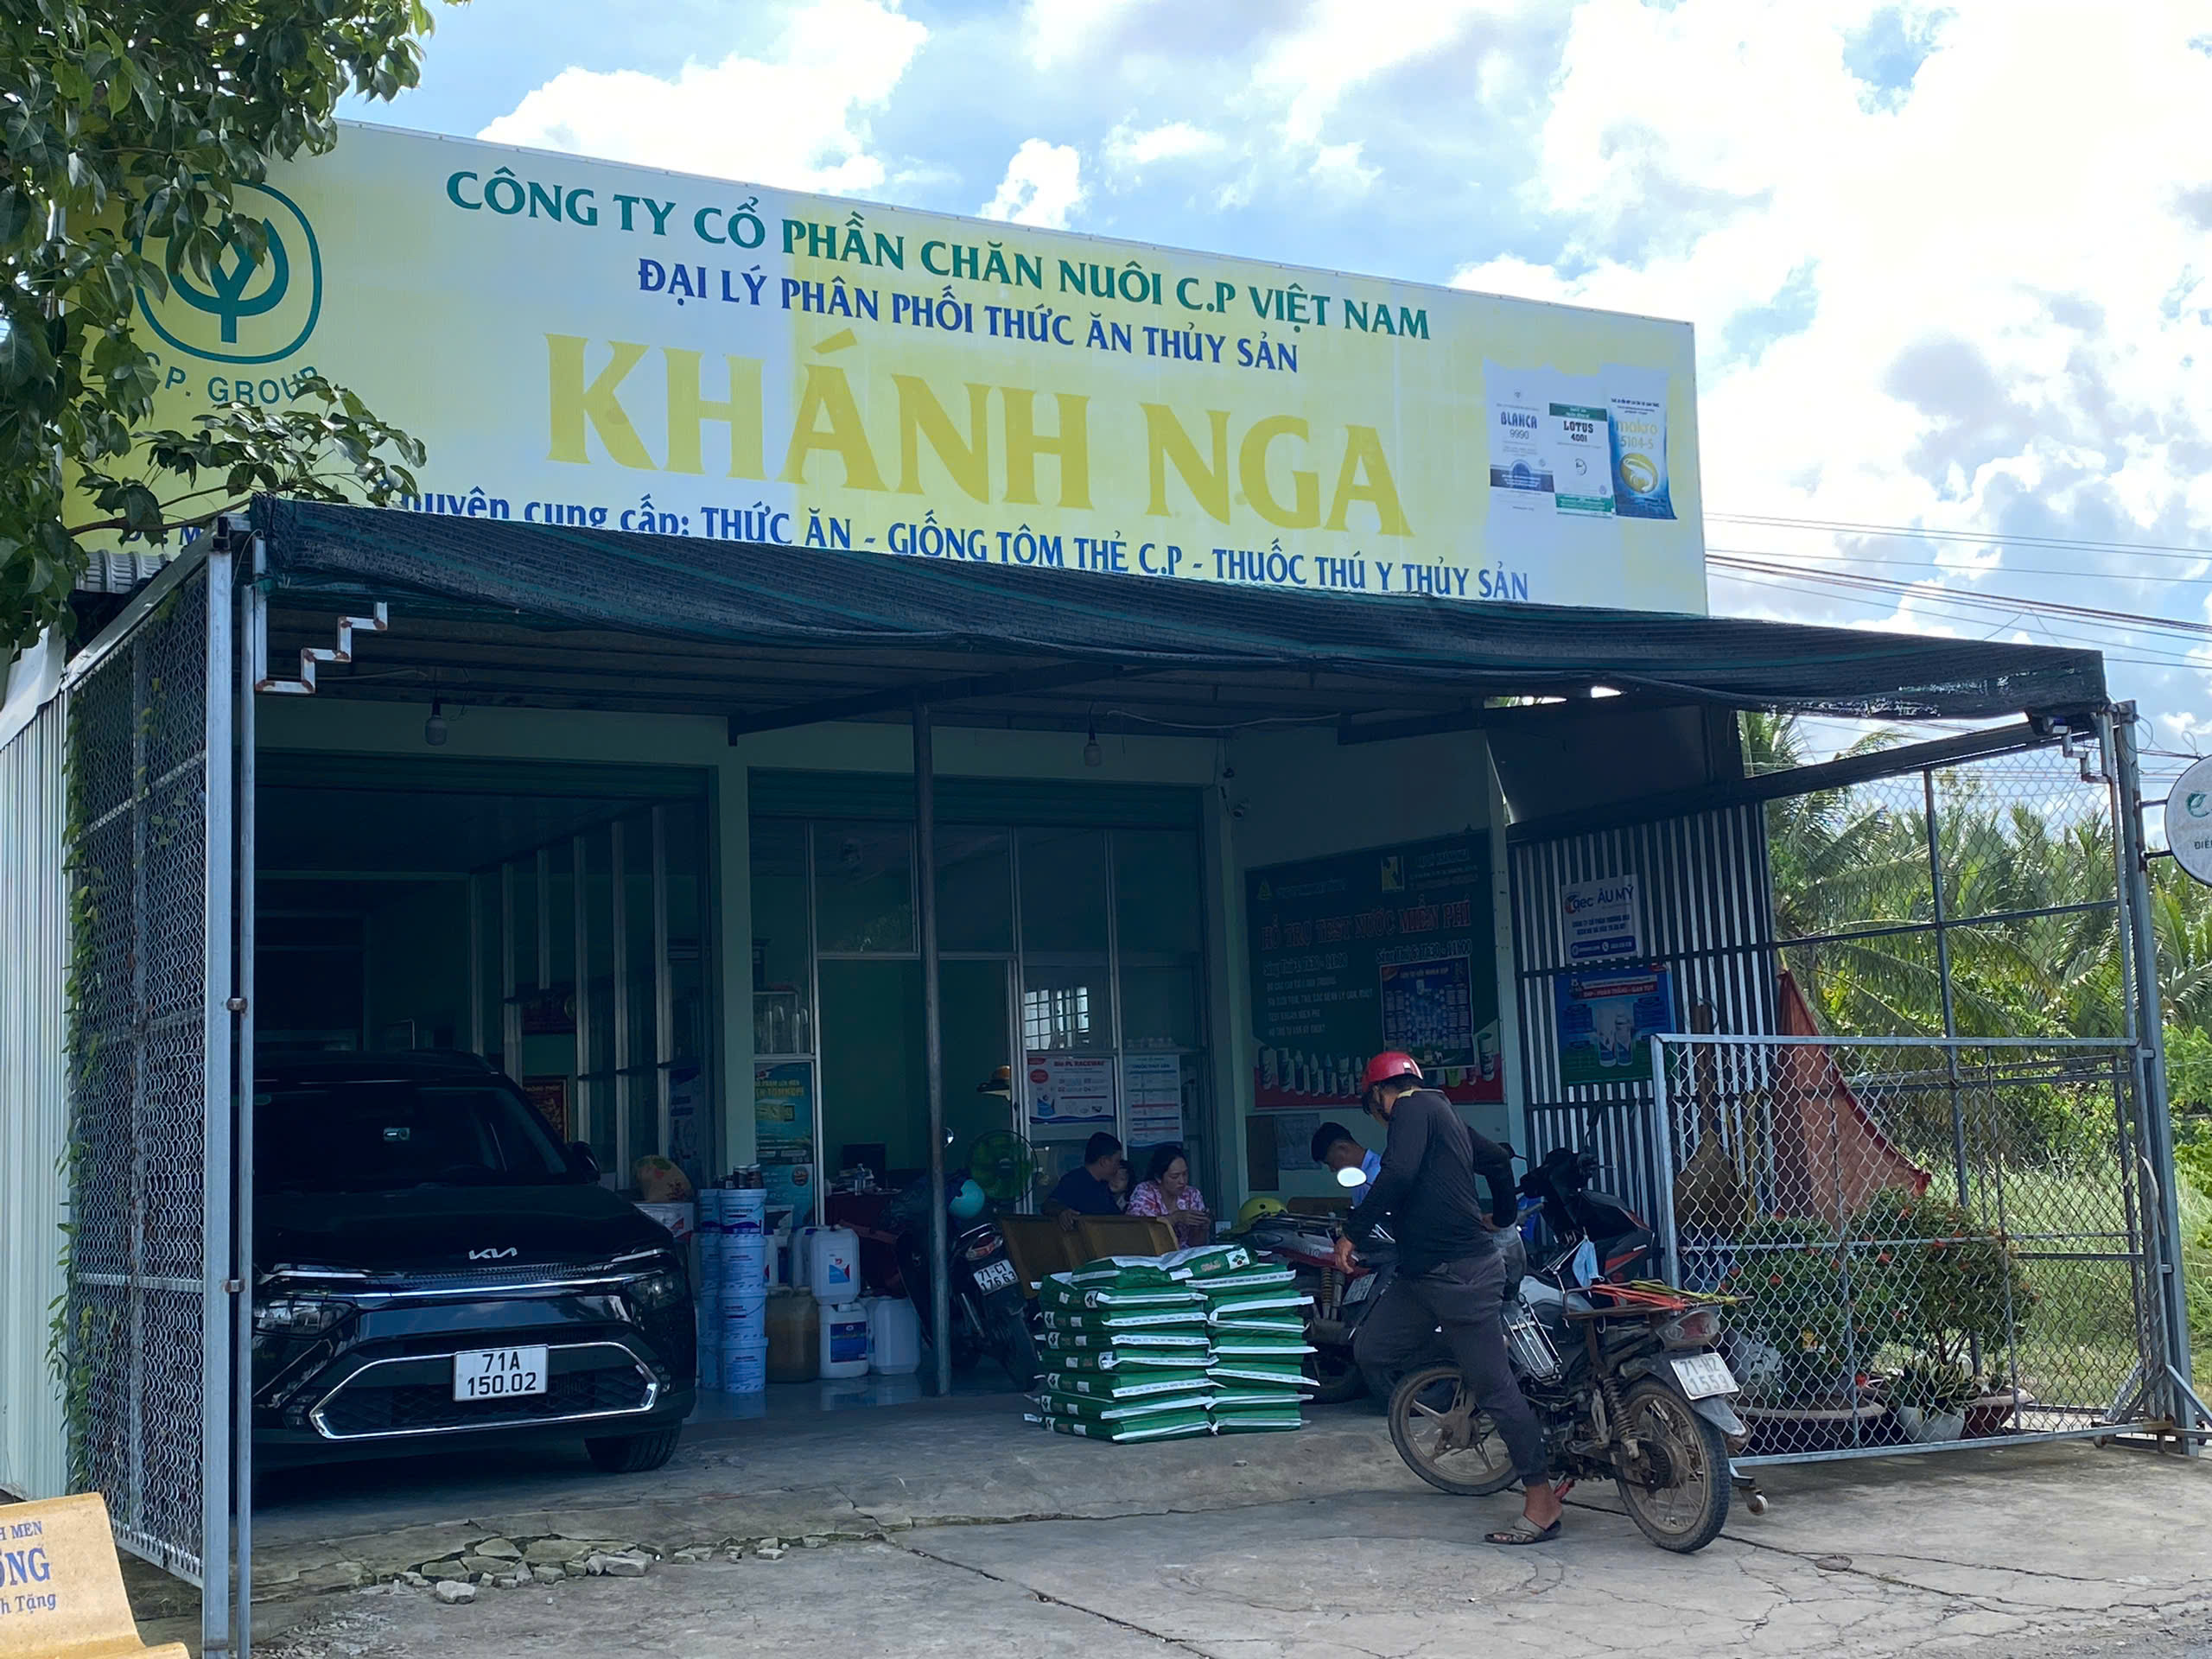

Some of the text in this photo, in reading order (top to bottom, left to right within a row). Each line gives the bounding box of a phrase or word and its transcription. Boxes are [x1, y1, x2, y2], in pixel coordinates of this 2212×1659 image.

[446, 165, 1431, 340] CÔNG TY CỔ PHẦN CHĂN NUÔI C.P VIỆT NAM
[638, 257, 1298, 373] ĐẠI LÝ PHÂN PHỐI THỨC ĂN THỦY SẢN
[1500, 410, 1538, 429] BLANCA
[1563, 421, 1594, 434] LOTUS
[544, 328, 1416, 539] KHÁNH NGA
[1571, 433, 1588, 443] 4001
[524, 502, 608, 527] cung
[701, 503, 792, 545] THỨC
[804, 507, 853, 549] ĂN
[887, 509, 988, 562] GIỐNG
[995, 524, 1065, 567] TÔM
[1073, 531, 1129, 571] THẺ
[1139, 543, 1183, 575] C.P
[1211, 537, 1307, 586] THUỐC
[1315, 550, 1366, 589] THÚ
[1375, 561, 1394, 591] Y
[1402, 556, 1470, 596] THỦY
[1478, 561, 1529, 601] SẢN
[482, 1351, 520, 1372] 71A
[467, 1372, 537, 1396] 150.02
[10, 1521, 42, 1539] MEN
[15, 1593, 56, 1614] Tặng
